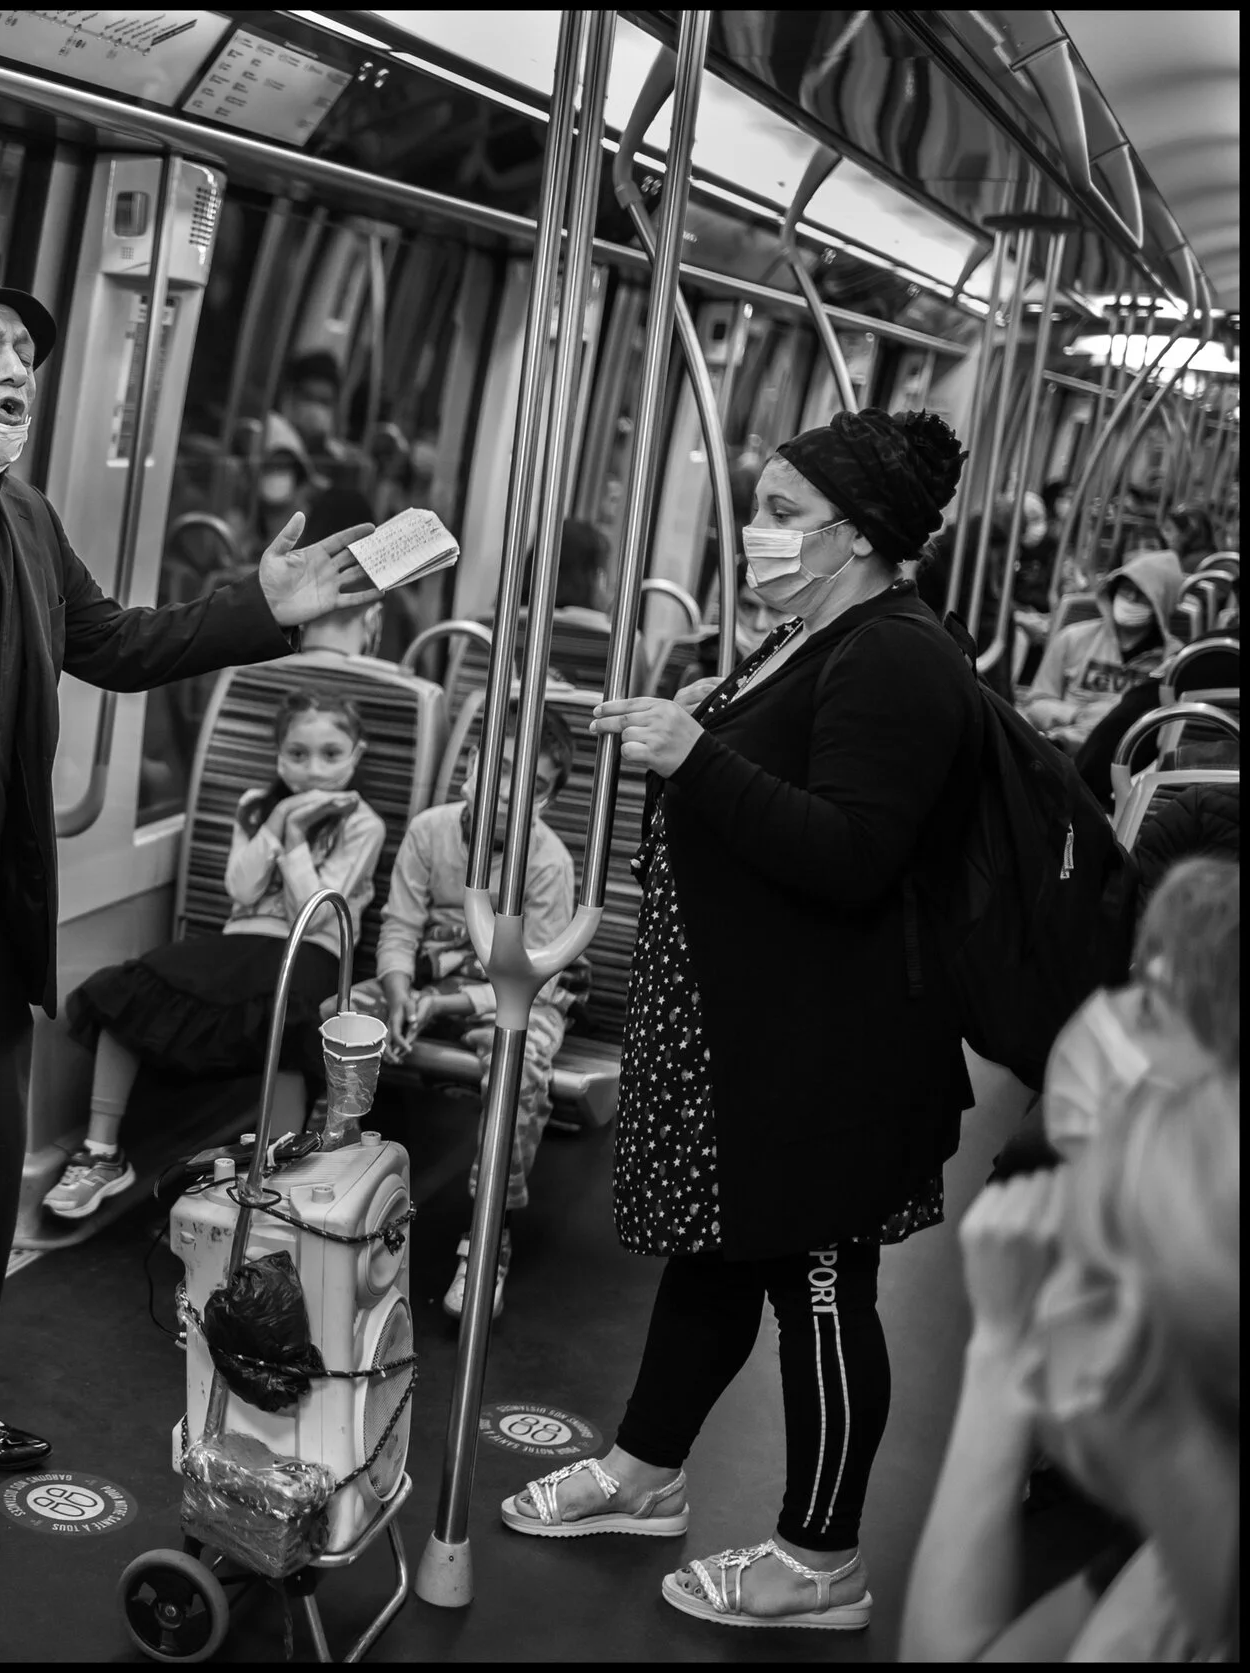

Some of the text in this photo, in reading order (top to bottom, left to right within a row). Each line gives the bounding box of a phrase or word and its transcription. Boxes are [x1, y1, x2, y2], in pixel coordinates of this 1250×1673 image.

[807, 1243, 839, 1316] PORT
[26, 1474, 72, 1484] GARDONS
[52, 1523, 80, 1532] TOUS
